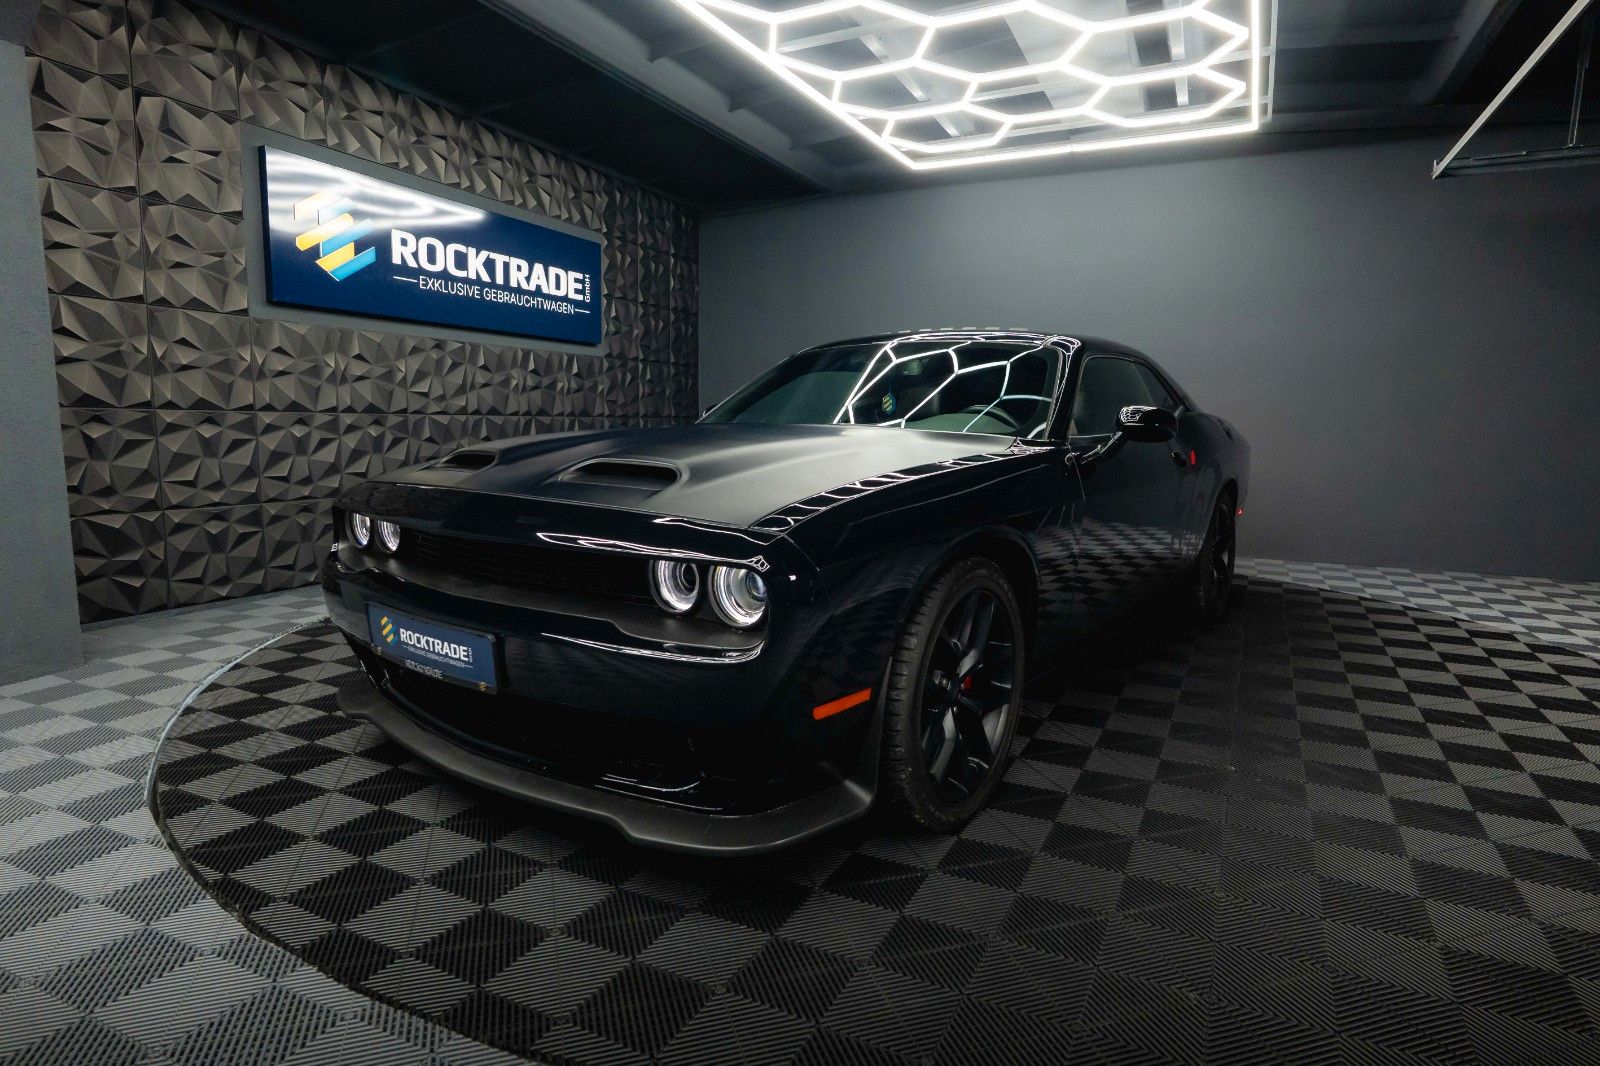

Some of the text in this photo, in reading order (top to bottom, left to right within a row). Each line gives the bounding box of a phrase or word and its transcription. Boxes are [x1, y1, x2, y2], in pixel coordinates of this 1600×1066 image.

[391, 229, 583, 300] ROCKTRADE
[419, 276, 575, 314] EXKLUSIVE GEBRAUCHTWAGEN
[400, 628, 468, 661] ROCKTRADE
